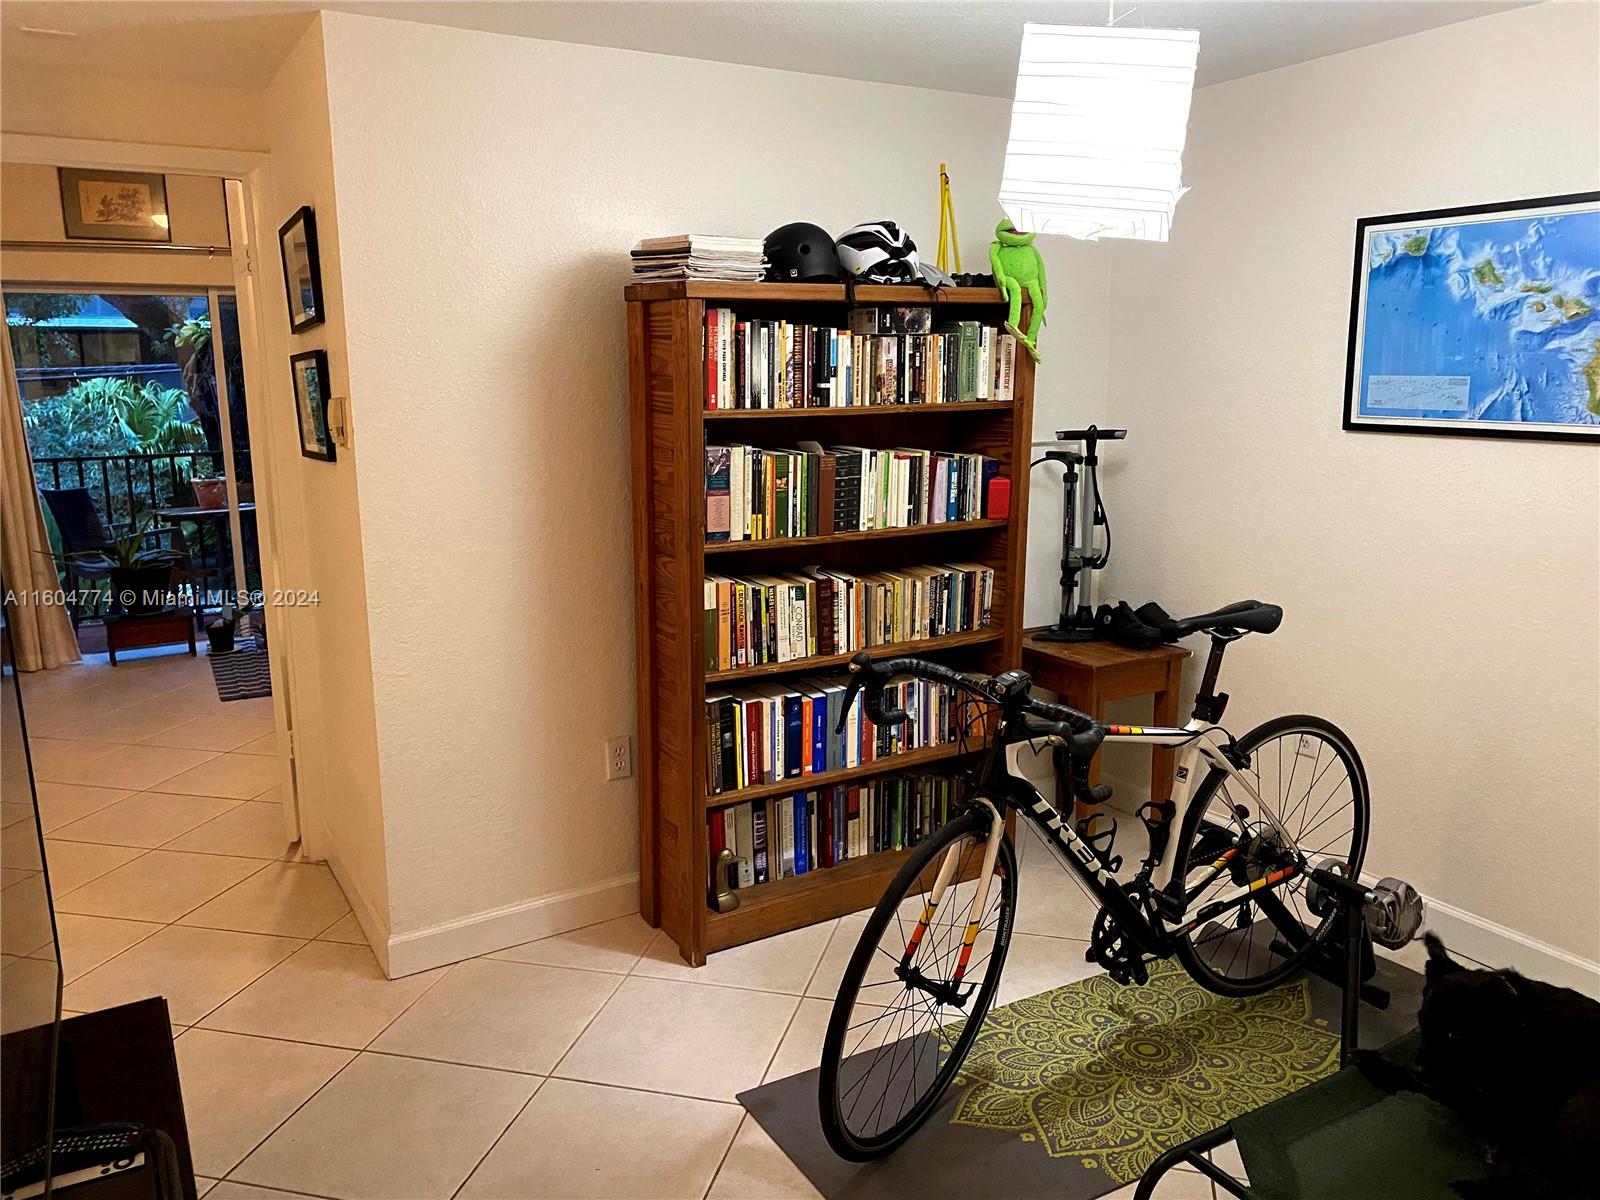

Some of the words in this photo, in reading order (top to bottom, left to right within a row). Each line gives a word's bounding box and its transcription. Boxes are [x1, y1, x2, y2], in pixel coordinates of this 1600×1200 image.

[795, 606, 803, 642] CONRAD
[1032, 790, 1113, 888] TREK
[1000, 906, 1009, 946] BONTRAGER
